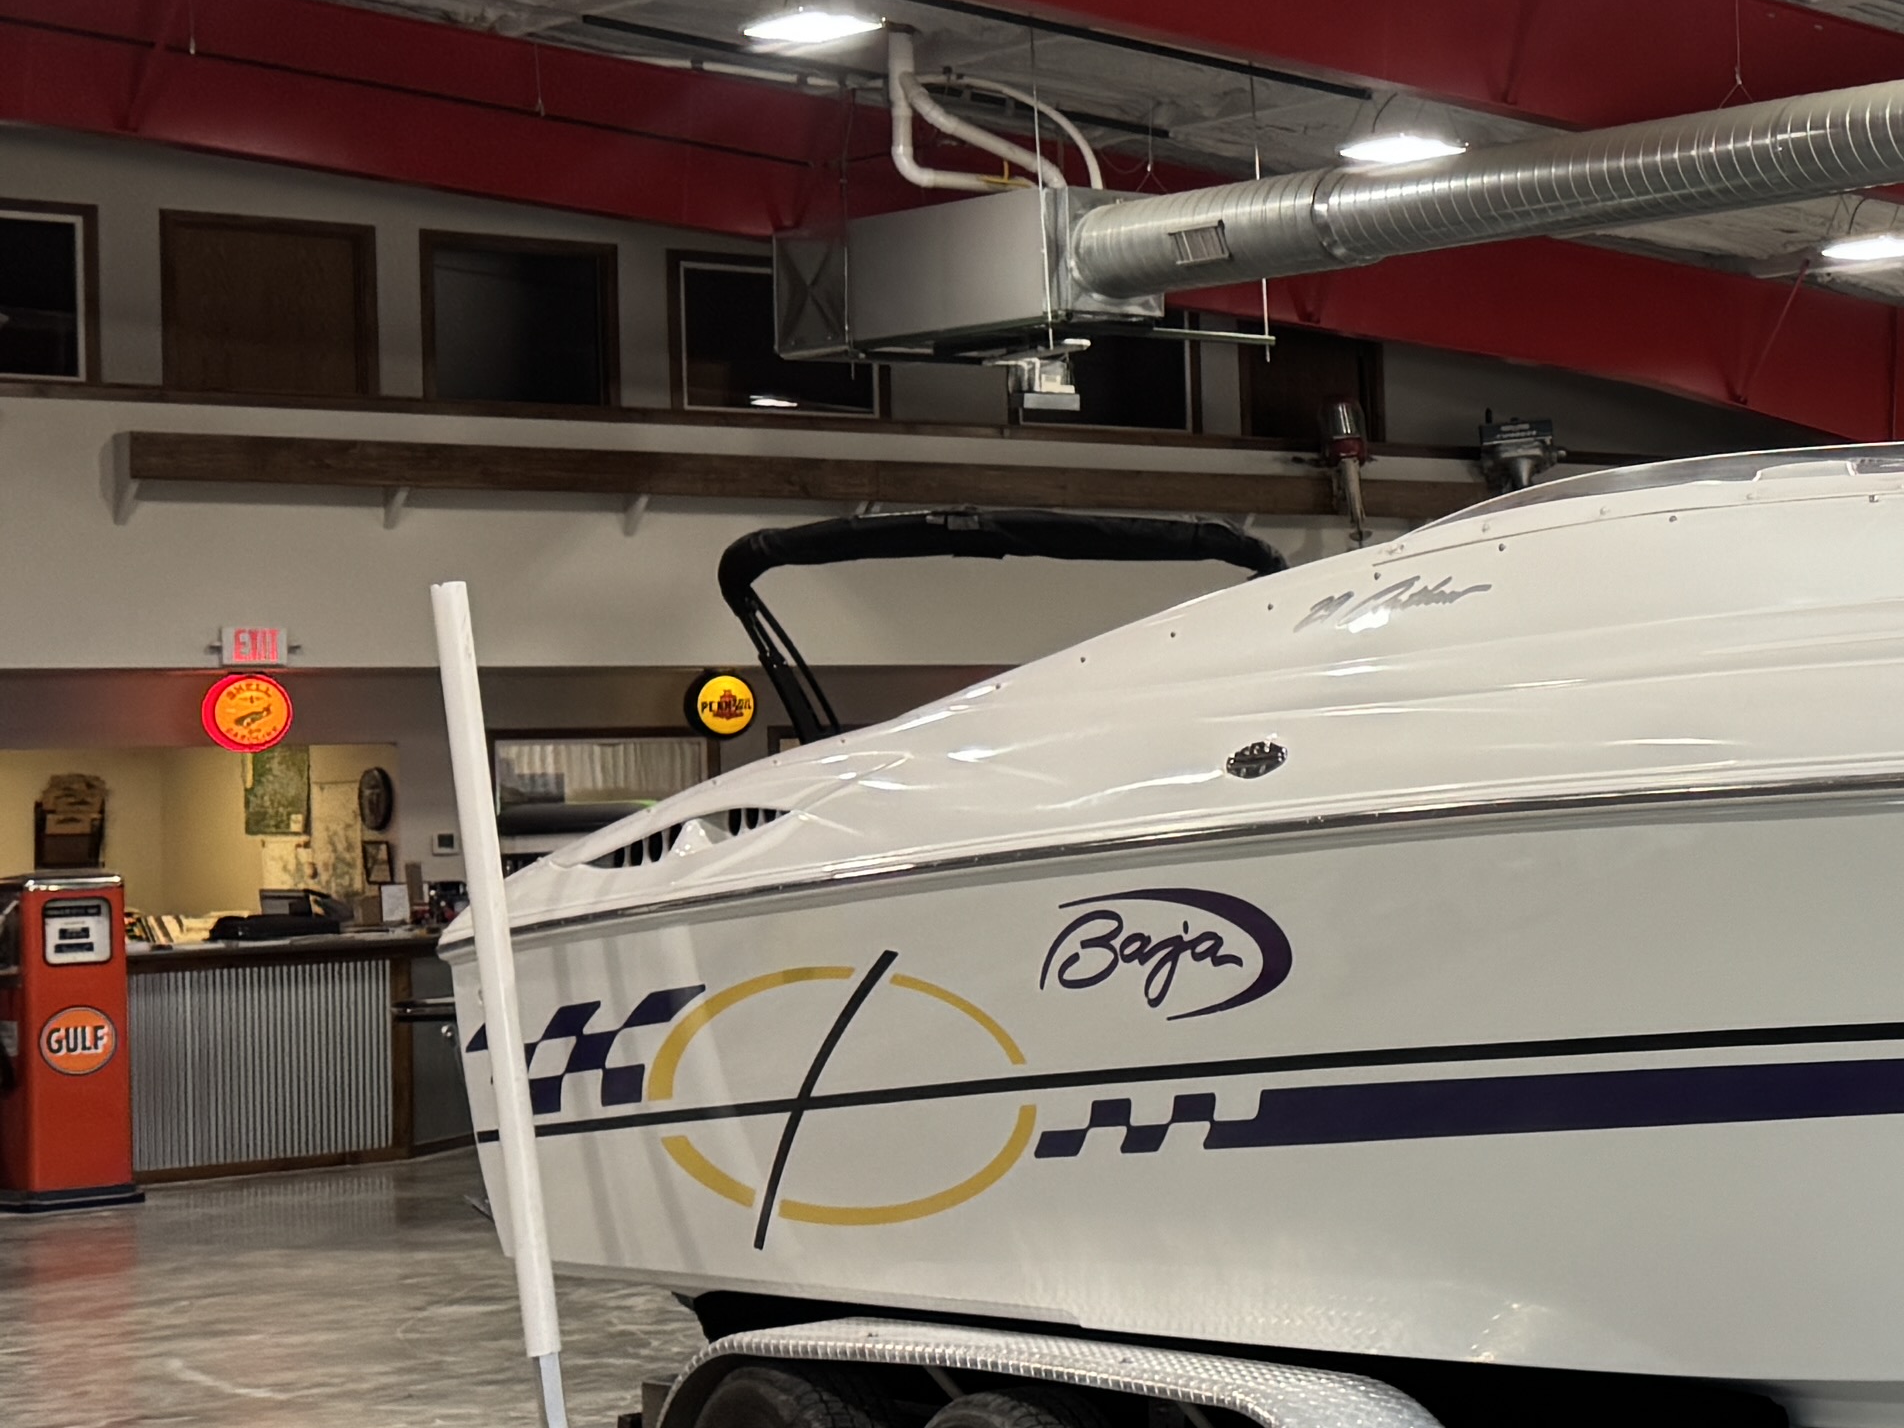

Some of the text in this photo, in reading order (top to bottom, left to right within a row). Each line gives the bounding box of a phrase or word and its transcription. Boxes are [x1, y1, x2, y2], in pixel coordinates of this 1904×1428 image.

[233, 629, 280, 663] EXIT
[226, 683, 272, 700] SHELL
[1040, 910, 1243, 1008] Baja
[46, 1025, 106, 1054] GULF
